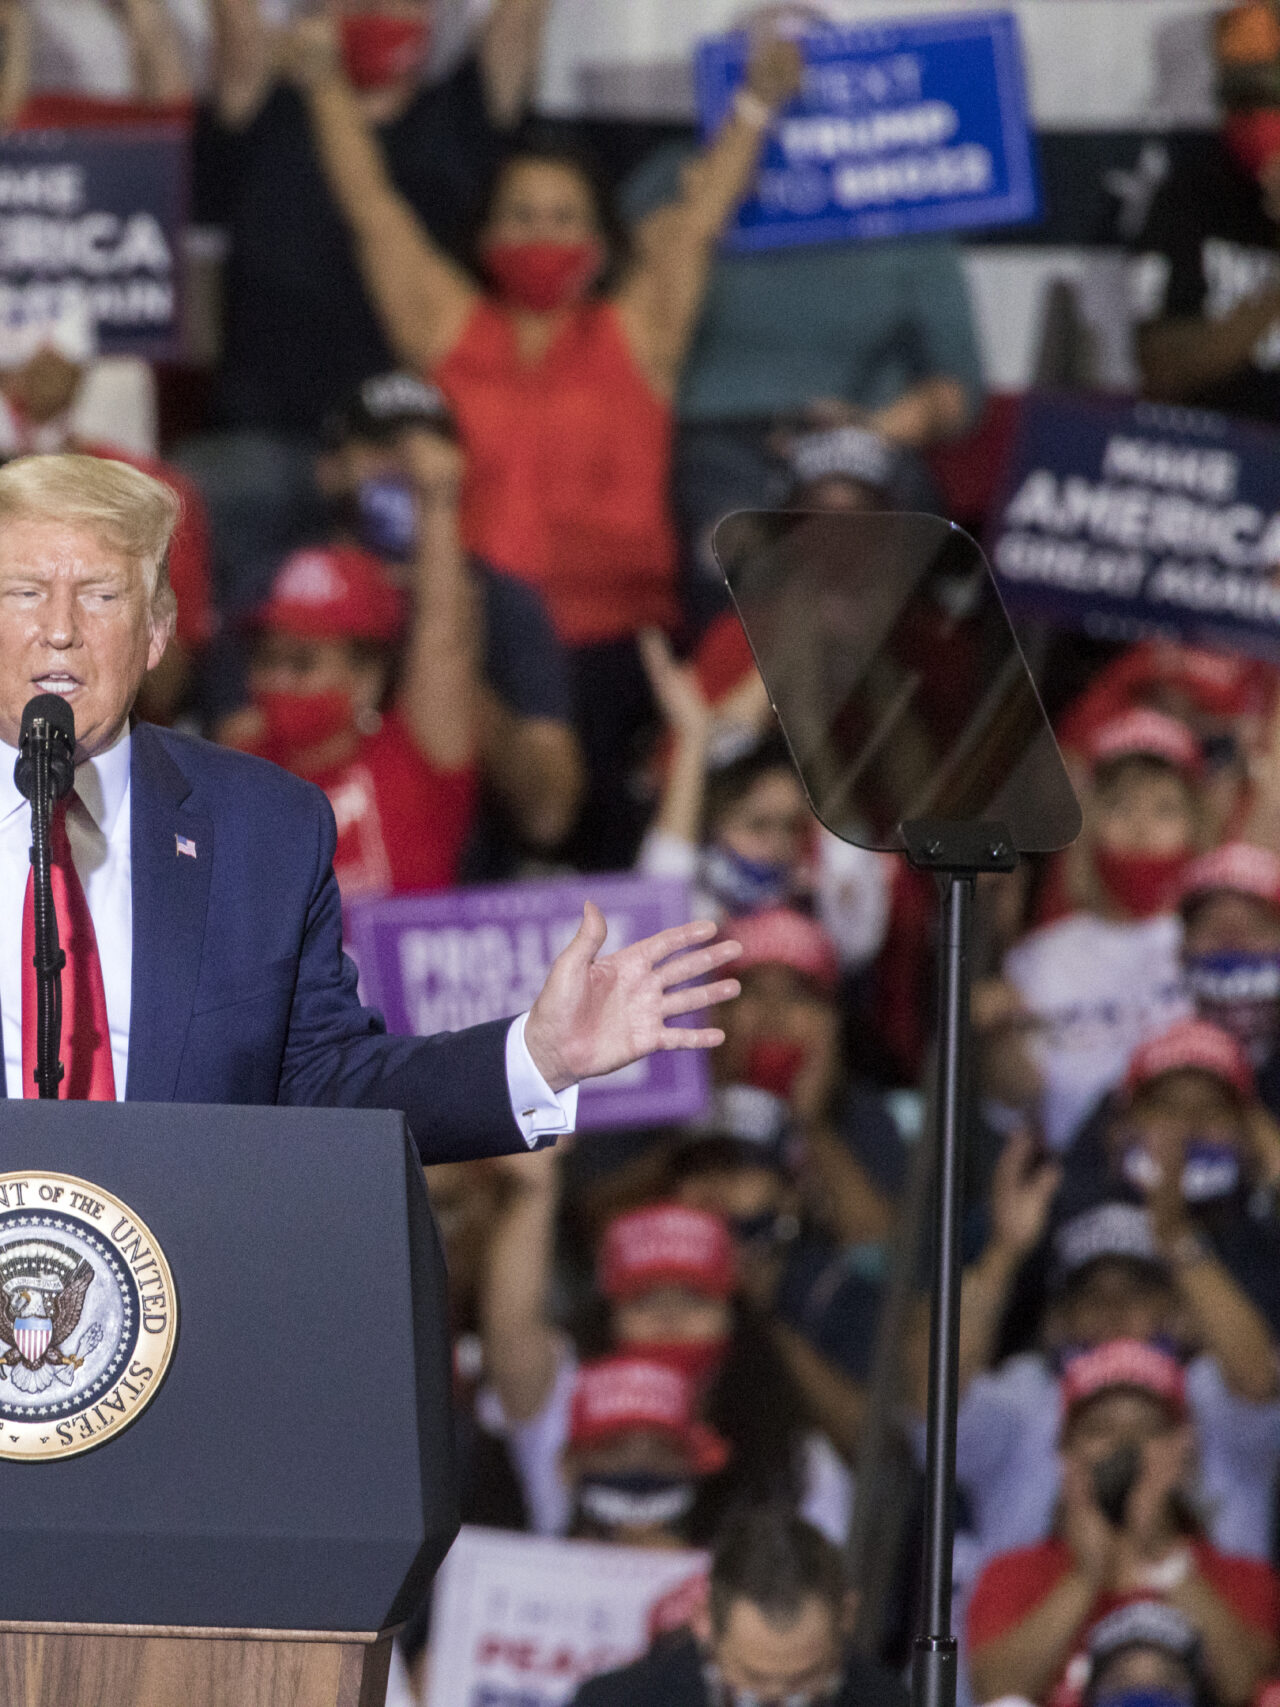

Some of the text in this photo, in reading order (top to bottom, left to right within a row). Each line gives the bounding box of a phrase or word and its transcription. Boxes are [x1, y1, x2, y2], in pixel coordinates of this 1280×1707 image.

[38, 1184, 65, 1203] OF
[70, 1190, 106, 1221] THE
[110, 1216, 169, 1335] UNITED
[56, 1360, 154, 1447] STATES
